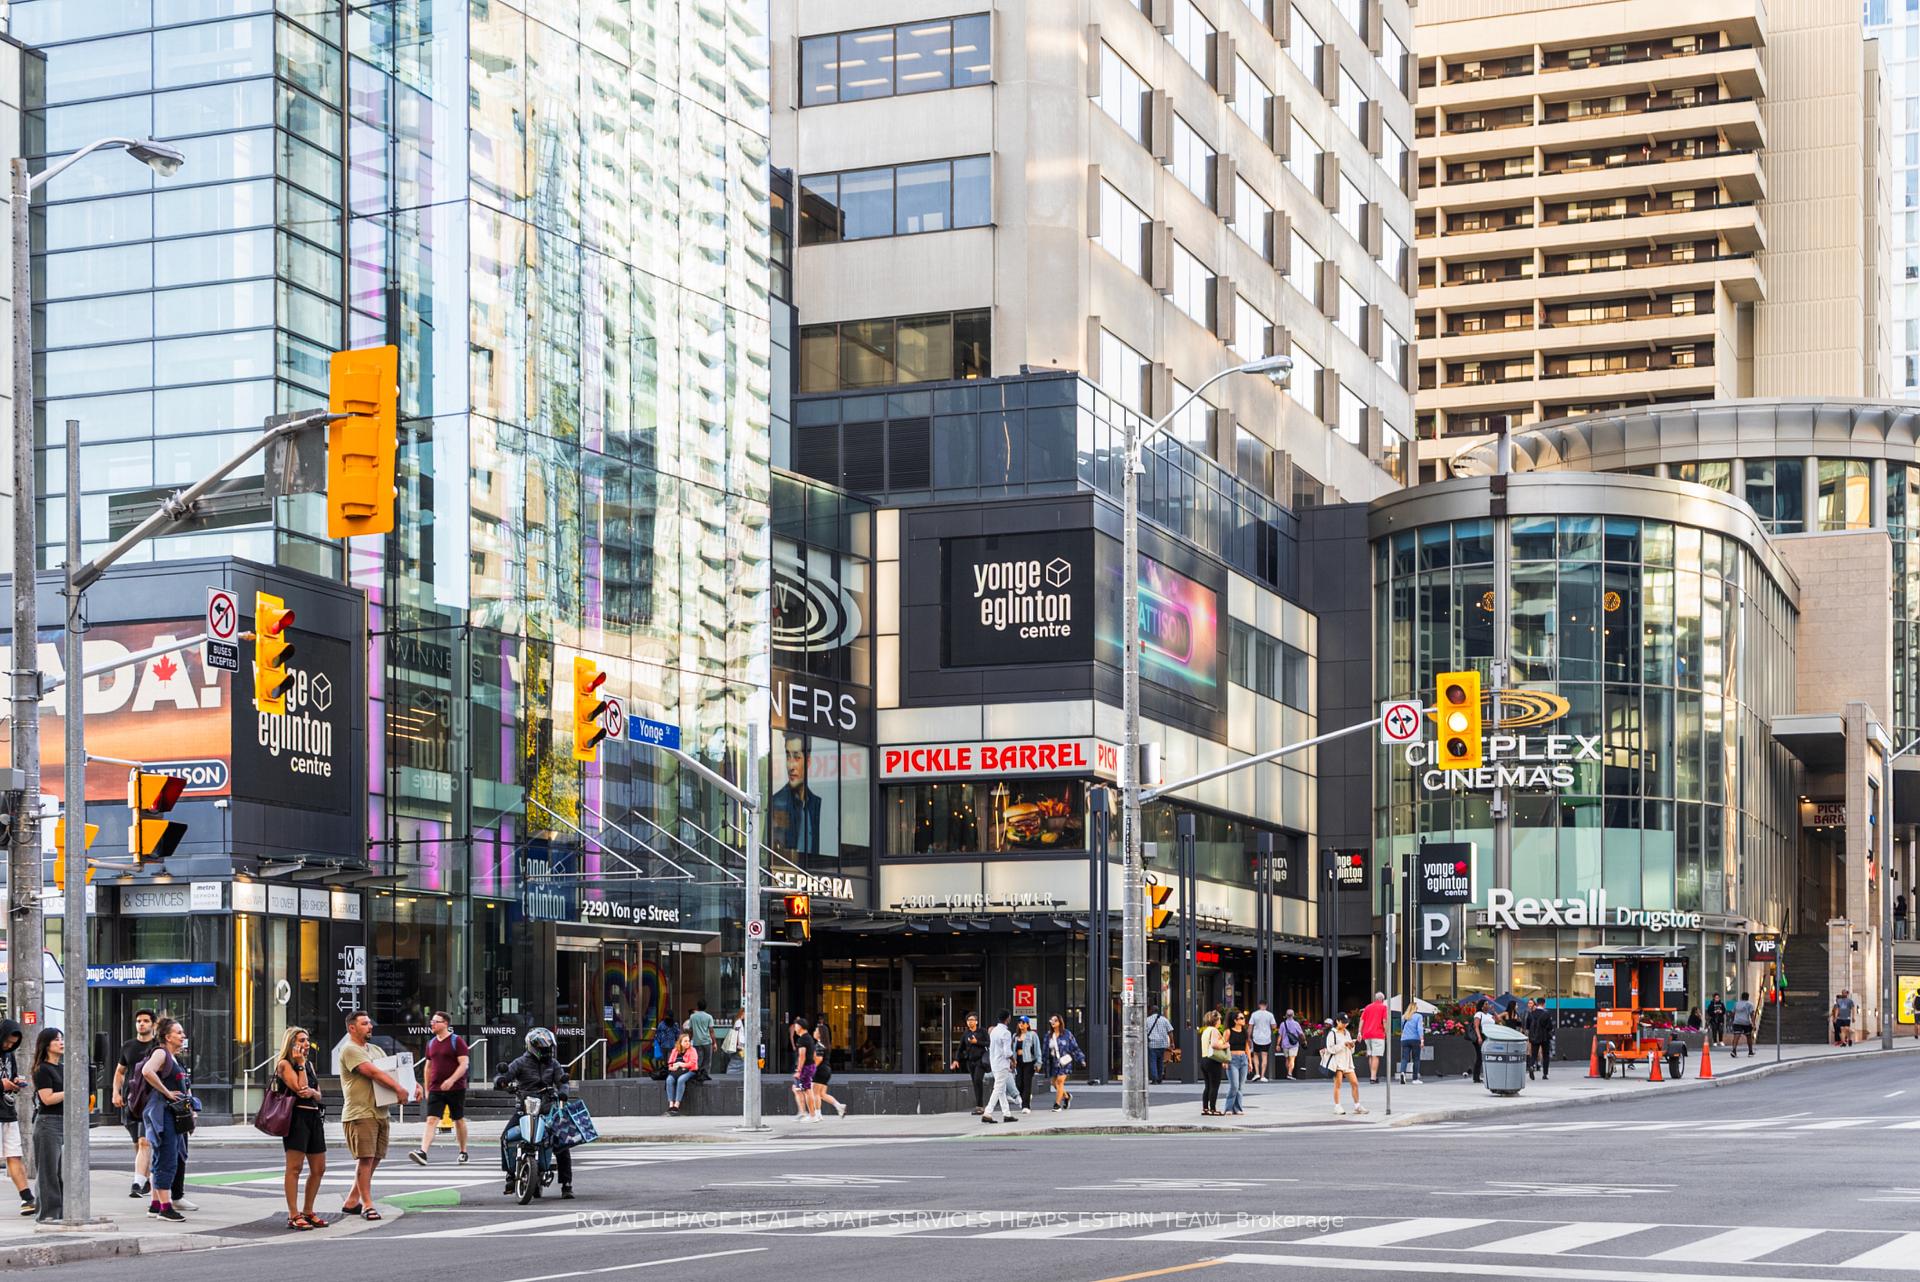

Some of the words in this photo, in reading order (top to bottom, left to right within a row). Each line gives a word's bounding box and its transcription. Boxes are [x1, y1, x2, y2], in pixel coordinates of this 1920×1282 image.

[973, 559, 1041, 598] yonge
[980, 590, 1071, 631] eglinton
[1019, 623, 1071, 638] centre
[1138, 601, 1187, 650] ATTISON
[213, 645, 232, 657] BUSES
[390, 638, 482, 678] WINNES
[208, 655, 237, 668] EXCEPTED
[258, 711, 332, 757] eglinton
[640, 720, 663, 744] Yonge
[290, 756, 332, 777] centre
[885, 747, 972, 773] PICKLE
[980, 742, 1088, 771] BARREL
[1423, 765, 1574, 791] CINEMAS
[1424, 862, 1454, 879] yonge
[775, 872, 854, 900] SEPHORA
[1427, 876, 1468, 892] eglinton
[135, 891, 184, 907] SERVICES
[900, 894, 935, 909] 2300
[944, 892, 992, 908] YONGE
[1001, 891, 1053, 906] TOWER
[582, 900, 609, 918] 2290
[648, 905, 680, 923] Street
[1487, 888, 1606, 930] Rexall
[1616, 906, 1700, 932] Drugstore
[1423, 912, 1451, 951] P
[1754, 942, 1776, 952] VIP
[86, 968, 104, 982] onge
[114, 965, 145, 981] eglinton
[170, 976, 185, 984] retail
[1018, 990, 1031, 1004] R
[408, 1026, 454, 1035] WINNS
[481, 1026, 516, 1035] WINNERS
